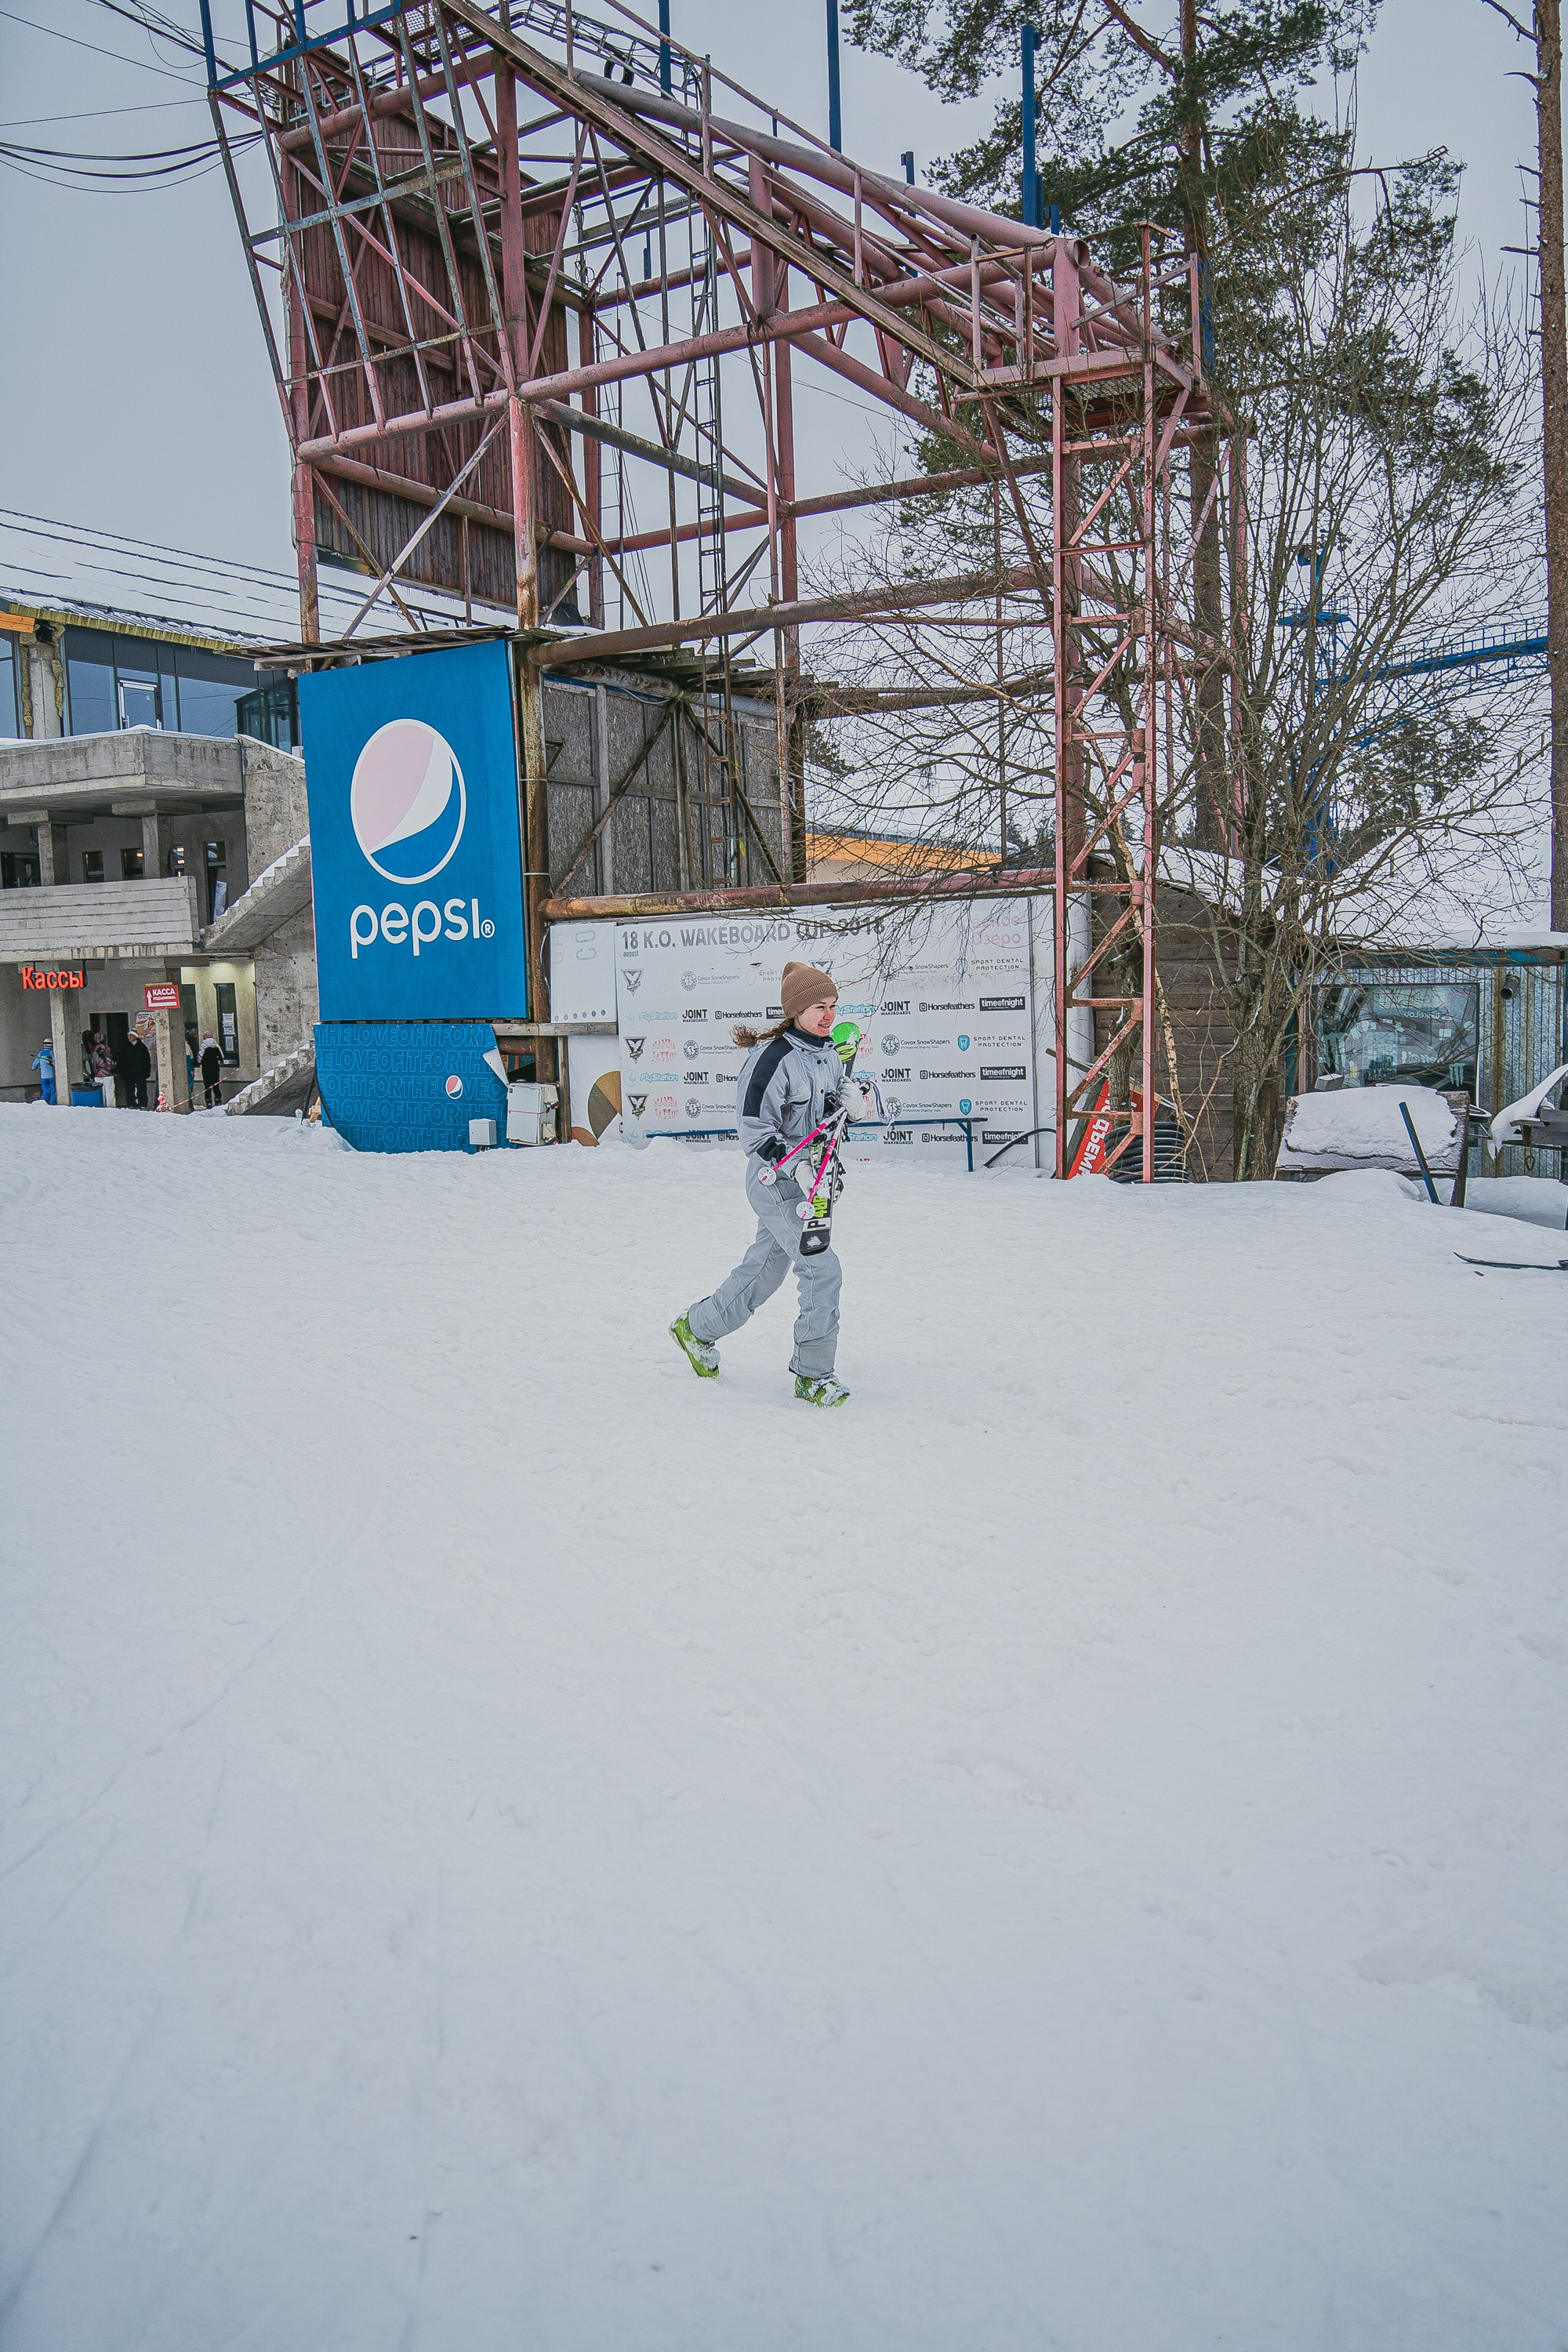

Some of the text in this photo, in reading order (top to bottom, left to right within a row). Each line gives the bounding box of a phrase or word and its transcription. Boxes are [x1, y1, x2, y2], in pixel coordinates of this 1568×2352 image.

[622, 931, 639, 949] 18
[643, 930, 676, 949] K.O.
[680, 923, 790, 947] WAKEBOARD
[21, 966, 84, 989] Кассы
[152, 988, 176, 996] КАССА
[835, 1004, 876, 1016] lyStation
[880, 1000, 911, 1011] JOINT
[927, 1002, 976, 1011] Horsefeathers
[681, 1008, 708, 1018] JOINT
[640, 1072, 679, 1083] FlyStation
[683, 1071, 710, 1081] JOINT
[880, 1068, 912, 1078] JOINT
[883, 1131, 913, 1141] JOINT
[931, 1134, 978, 1142] Horsefeathrs
